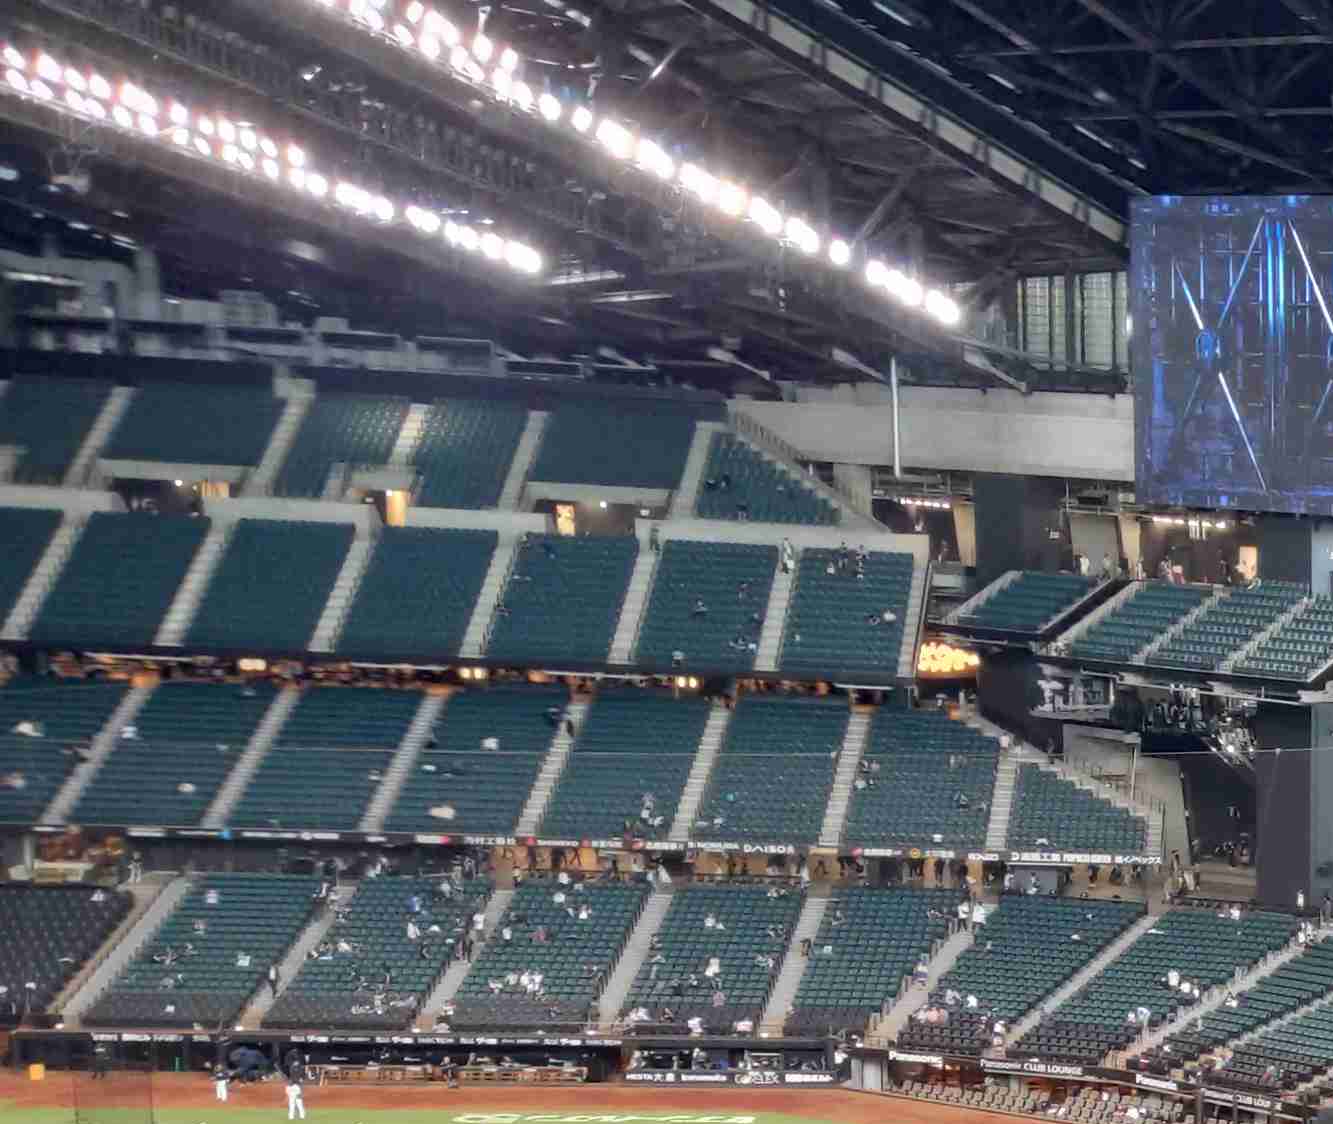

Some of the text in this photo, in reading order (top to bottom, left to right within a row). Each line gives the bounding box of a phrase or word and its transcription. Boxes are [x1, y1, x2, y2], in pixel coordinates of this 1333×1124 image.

[888, 1050, 944, 1068] Panasonic
[1023, 1060, 1046, 1074] CLUB
[1046, 1063, 1084, 1077] LOUNGE
